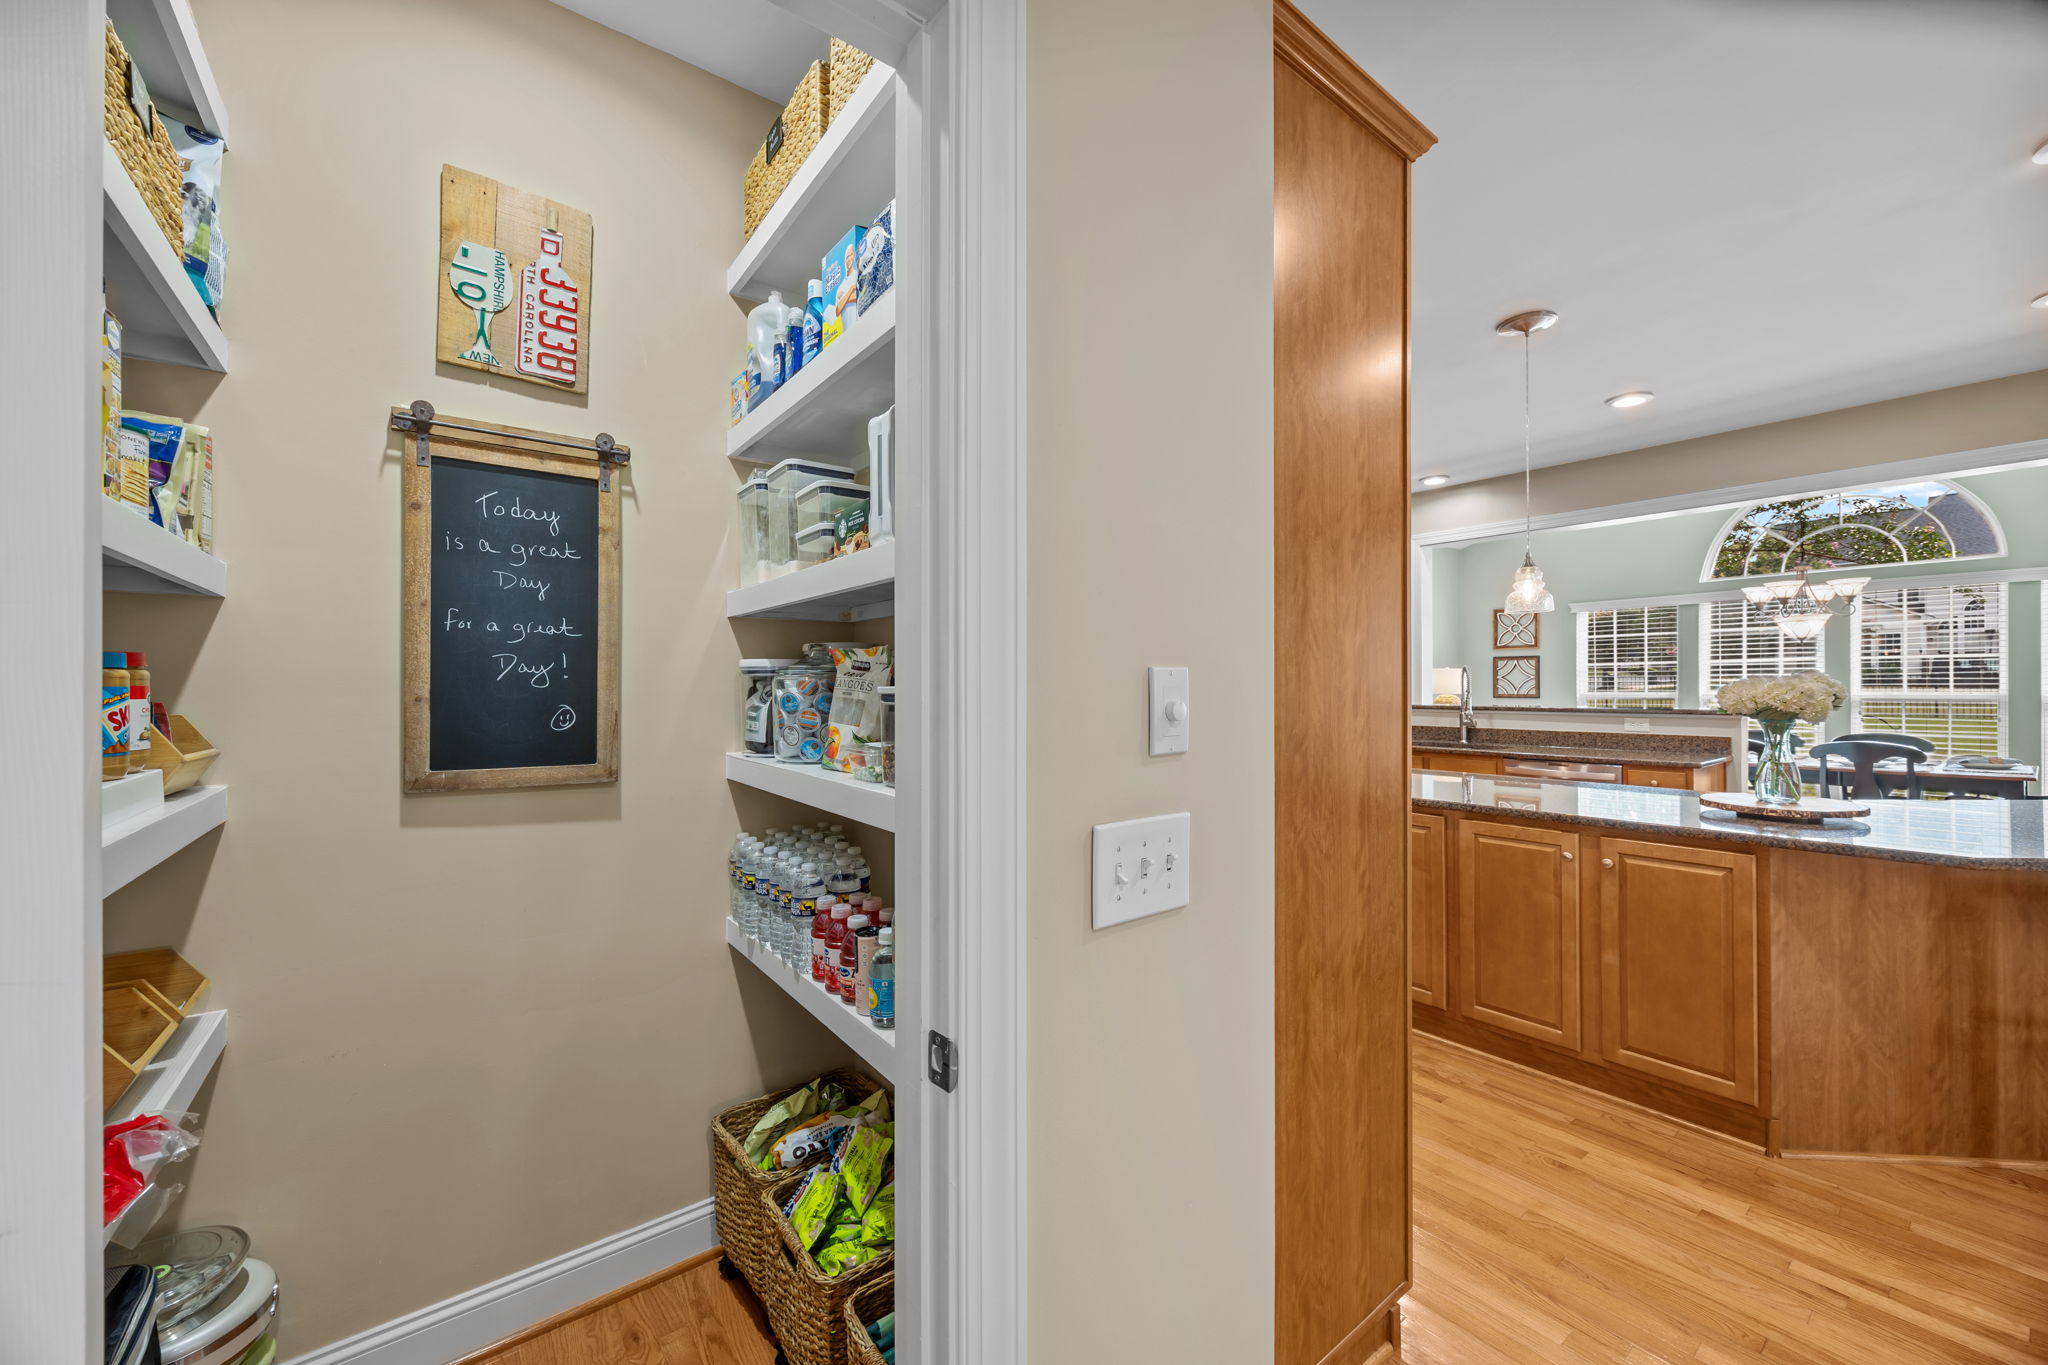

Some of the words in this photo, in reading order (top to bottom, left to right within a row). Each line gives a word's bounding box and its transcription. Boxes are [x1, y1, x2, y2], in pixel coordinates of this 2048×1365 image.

[525, 294, 536, 364] CAROLINA
[475, 490, 561, 537] Today
[445, 531, 464, 551] is
[478, 538, 502, 553] a
[510, 542, 582, 567] great
[492, 570, 550, 601] Day
[486, 621, 501, 632] a
[506, 617, 583, 644] great
